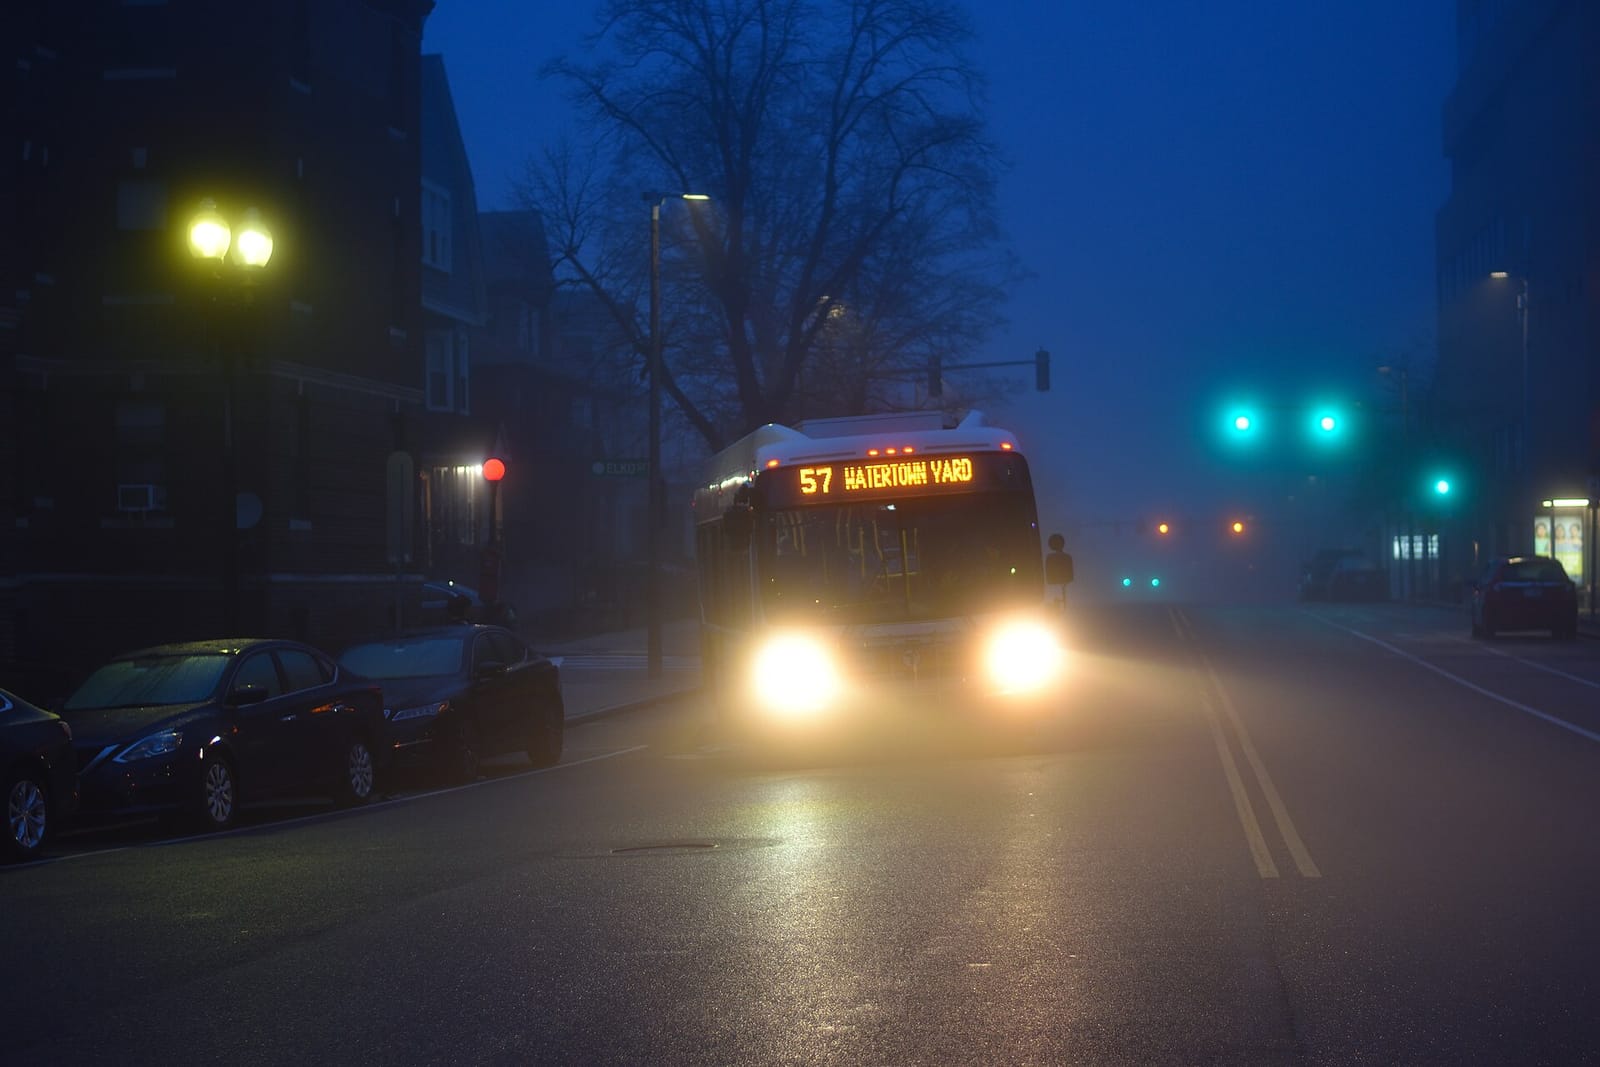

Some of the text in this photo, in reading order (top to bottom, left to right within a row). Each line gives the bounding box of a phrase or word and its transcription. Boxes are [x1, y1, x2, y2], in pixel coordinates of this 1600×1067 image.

[799, 458, 972, 494] 57 WATERTOWN YARD
